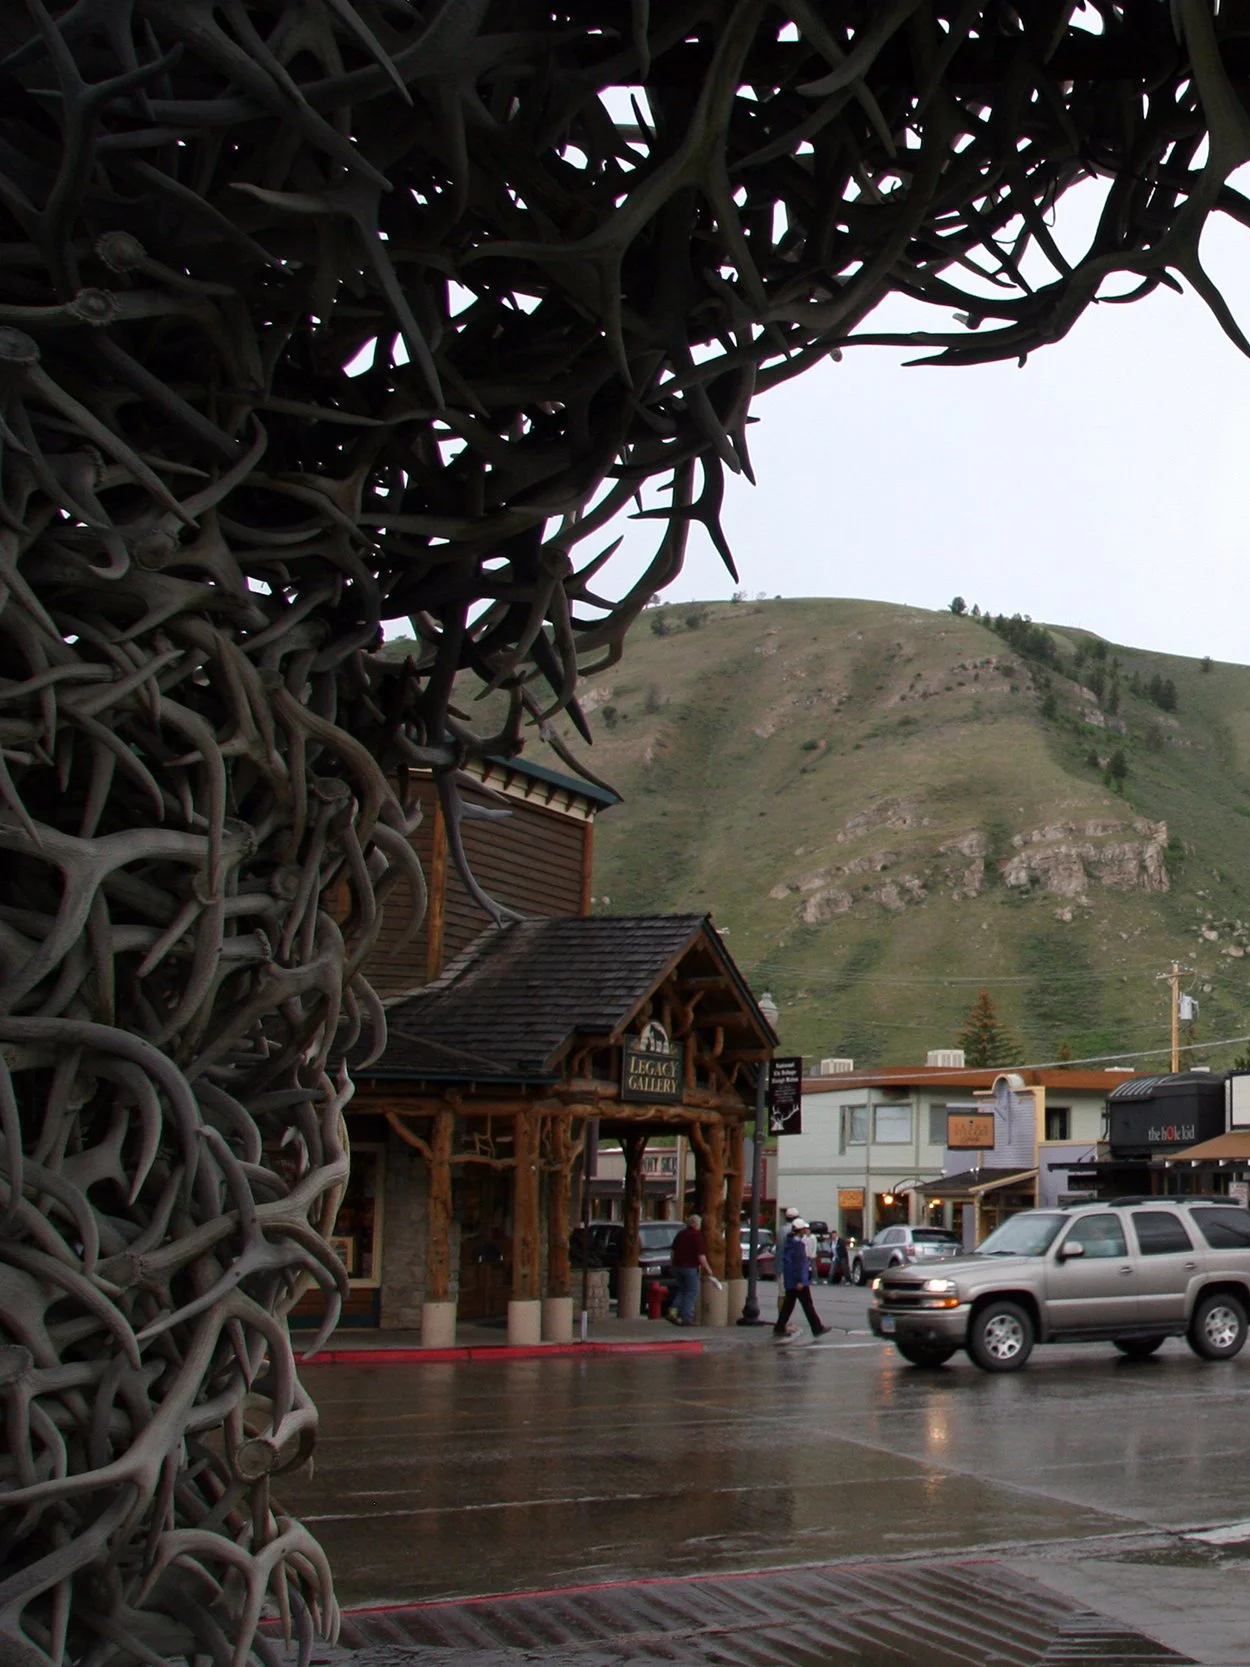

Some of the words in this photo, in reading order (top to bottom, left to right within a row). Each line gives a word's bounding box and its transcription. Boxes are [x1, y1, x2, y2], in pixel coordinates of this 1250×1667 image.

[630, 1056, 679, 1077] LEGACY
[628, 1075, 678, 1093] GALLERY
[1148, 1126, 1160, 1141] the
[1181, 1124, 1195, 1140] kid
